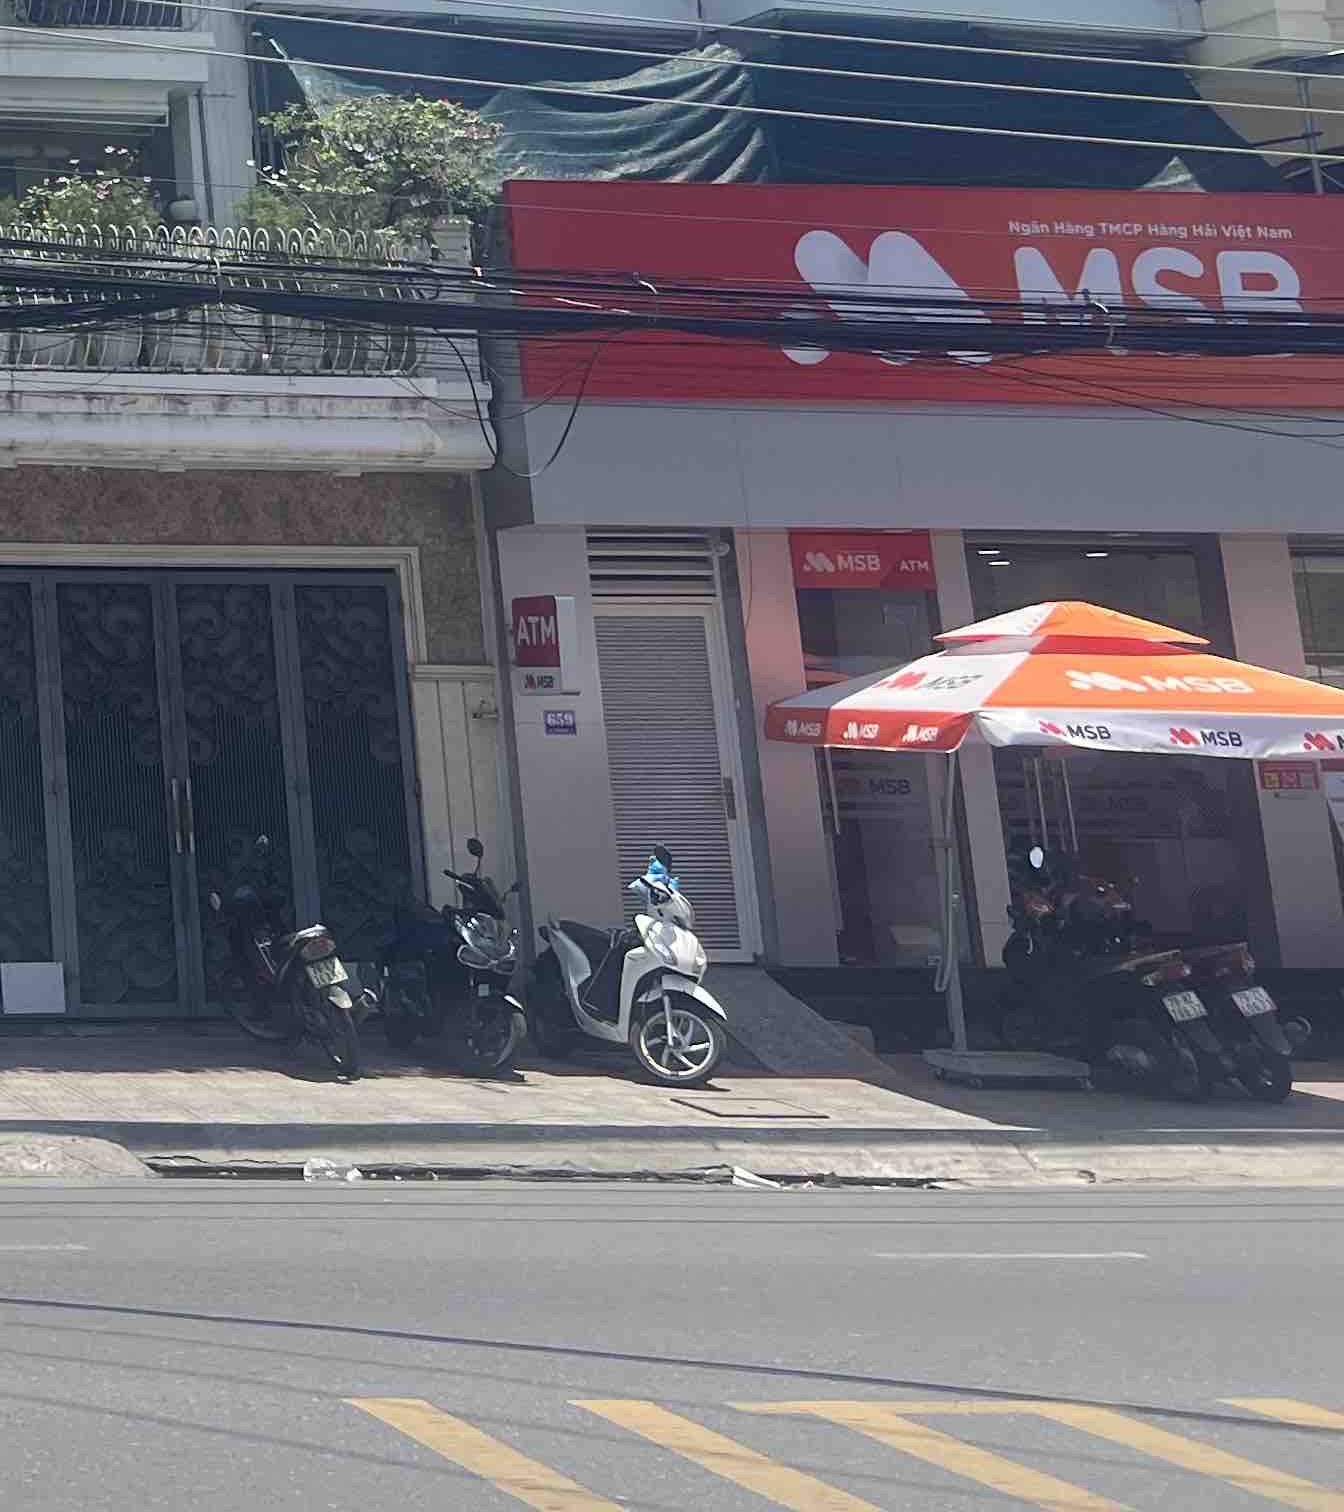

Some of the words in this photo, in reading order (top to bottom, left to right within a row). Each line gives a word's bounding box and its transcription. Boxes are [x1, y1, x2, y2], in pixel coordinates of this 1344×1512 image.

[1009, 221, 1050, 236] Ngân
[1054, 221, 1094, 236] Hàng
[1100, 223, 1143, 235] TMCP
[1148, 222, 1188, 238] Hàng
[1222, 224, 1252, 239] Việt
[1257, 226, 1293, 239] Nam
[838, 554, 881, 572] MSB
[899, 560, 929, 572] ATM
[517, 615, 556, 647] ATM
[1142, 674, 1256, 694] MSB
[1067, 724, 1112, 740] MSB
[1200, 730, 1244, 748] MSB
